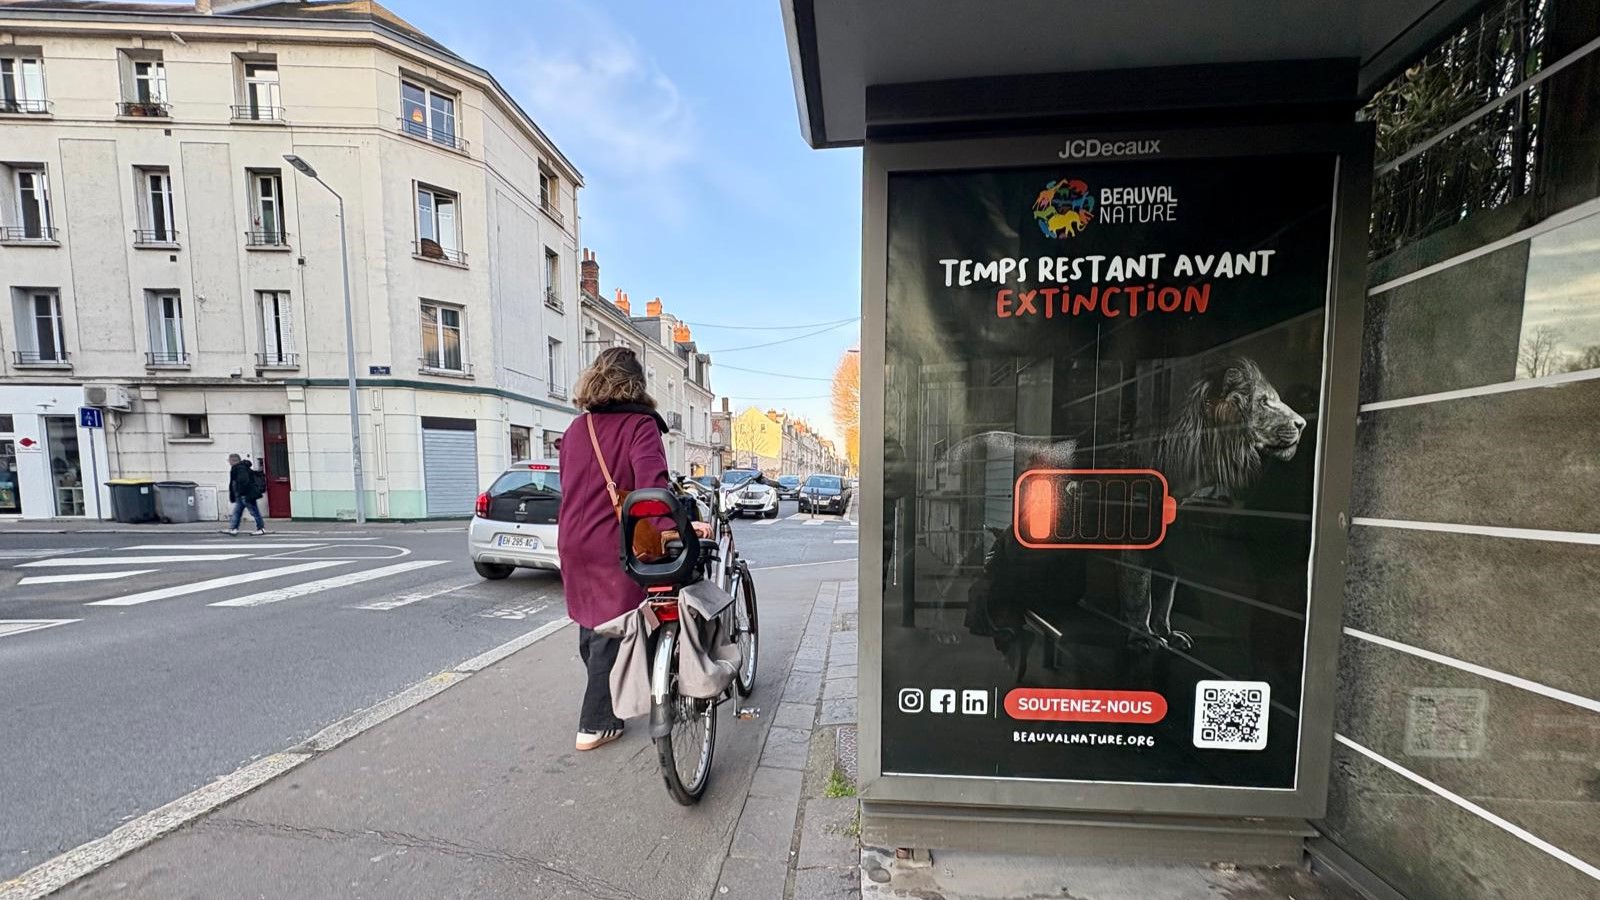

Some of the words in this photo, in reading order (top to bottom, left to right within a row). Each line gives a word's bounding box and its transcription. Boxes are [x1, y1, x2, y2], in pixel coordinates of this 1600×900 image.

[1058, 139, 1161, 159] JCDecaux
[1099, 186, 1178, 205] BEAUVAL
[1099, 203, 1177, 224] NATURE
[939, 256, 1030, 287] TEMPS
[1038, 253, 1167, 284] RESTANT
[1173, 249, 1276, 279] AVANT
[1017, 696, 1153, 715] SOUTENEZ-NOUS
[1012, 730, 1155, 748] BEAUVALNATURE.ORG
